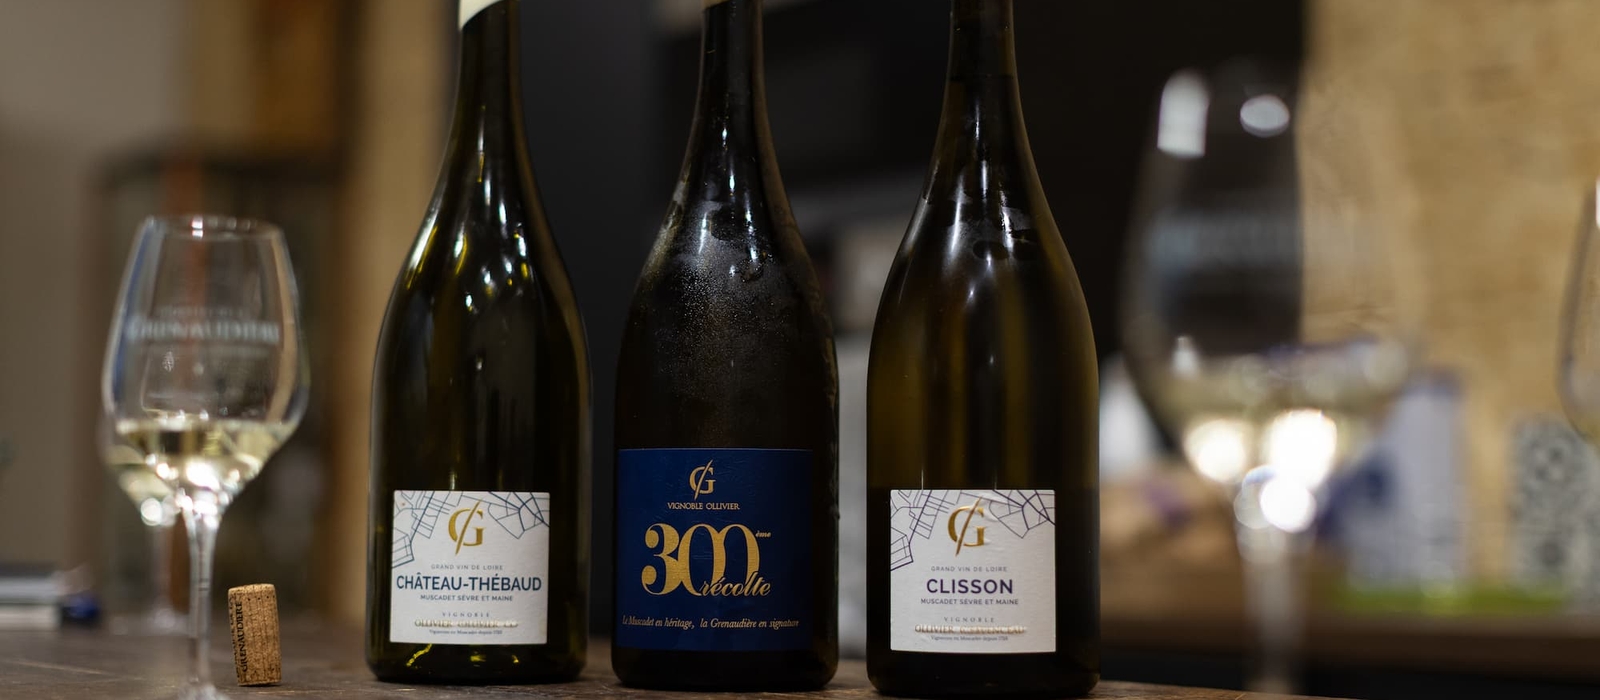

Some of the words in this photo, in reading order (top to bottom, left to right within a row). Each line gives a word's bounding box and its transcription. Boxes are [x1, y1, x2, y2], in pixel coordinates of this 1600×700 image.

[667, 502, 703, 510] VIGNOBLE
[706, 502, 740, 510] OLLIVIER
[641, 523, 760, 596] 300
[396, 572, 542, 592] CHÂTEAU-THÉBAUD
[700, 571, 771, 597] récolte
[926, 579, 1013, 594] CLISSON
[629, 616, 654, 627] Muscadet
[655, 619, 663, 627] en
[664, 617, 695, 630] héritage,
[700, 618, 708, 628] la
[710, 617, 756, 628] Grenaudière
